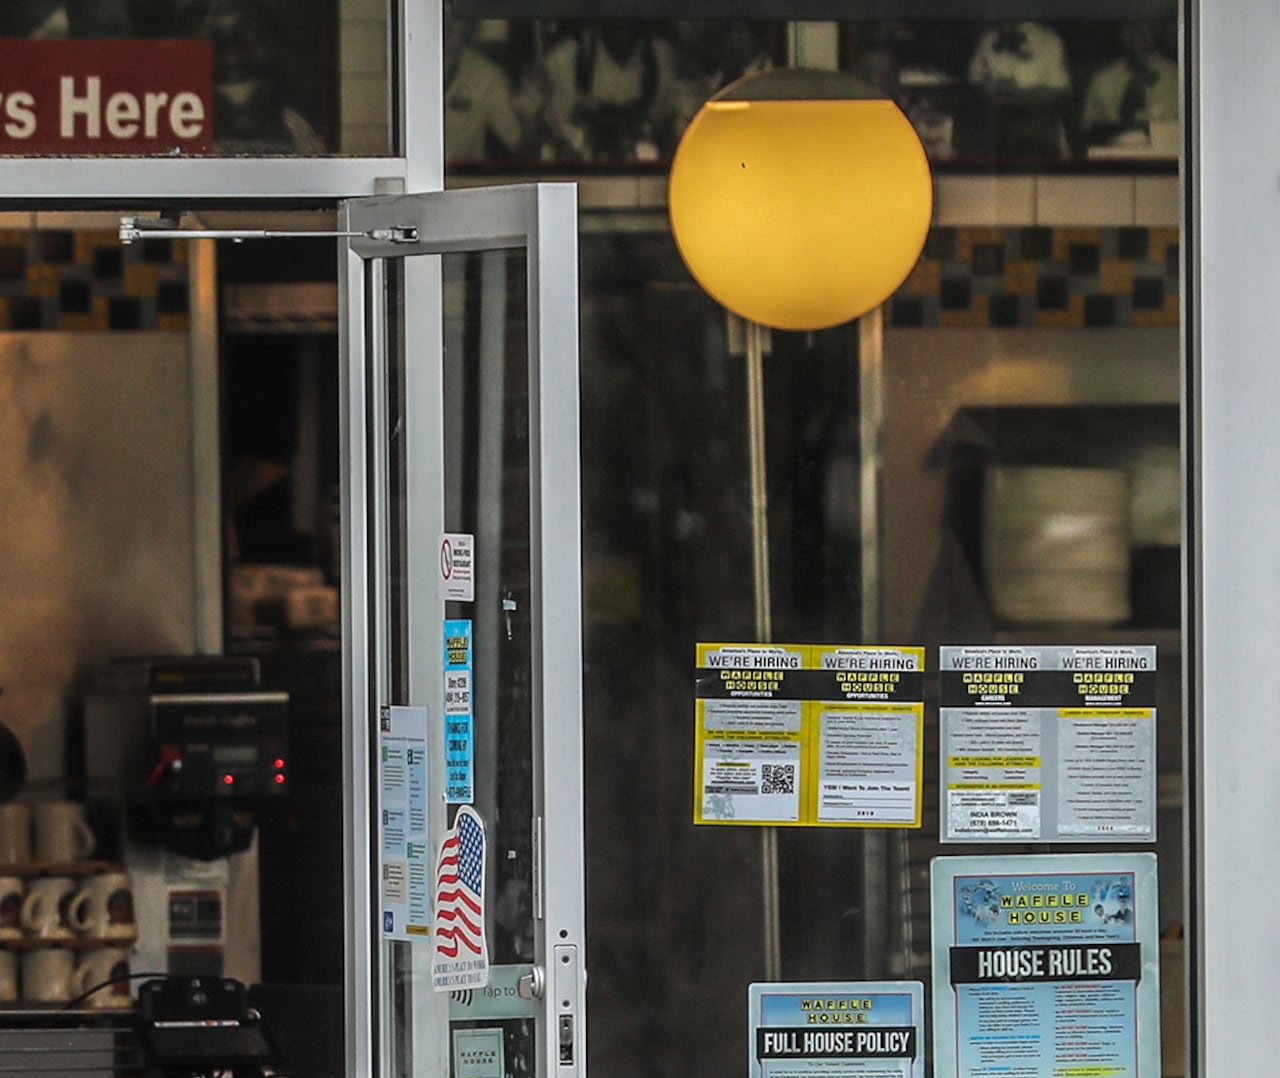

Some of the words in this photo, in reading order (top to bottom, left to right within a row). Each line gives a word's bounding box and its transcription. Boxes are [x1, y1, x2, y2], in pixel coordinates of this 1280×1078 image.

[59, 74, 206, 140] Here
[708, 655, 750, 667] WE'RE
[754, 657, 799, 668] HIRING
[824, 657, 866, 669] WE'RE
[870, 659, 915, 670] HIRING
[952, 657, 992, 669] WE'RE
[995, 657, 1038, 669] HIRING
[1062, 657, 1102, 669] WE'RE
[1105, 657, 1148, 669] HIRING
[720, 670, 784, 680] WAFFLE
[836, 672, 900, 682] WAFFLE
[963, 673, 1024, 683] WAFFLE
[1073, 673, 1135, 683] WAFFLE
[725, 681, 779, 690] HOUSE
[841, 683, 894, 692] HOUSE
[967, 684, 1019, 694] HOUSE
[1078, 684, 1129, 694] HOUSE
[1011, 880, 1060, 892] Welcome
[1063, 880, 1077, 891] To
[1000, 893, 1089, 909] WAFFLE
[1008, 910, 1083, 925] HOUSE
[978, 950, 1045, 978] HOUSE
[1049, 947, 1113, 976] RULES
[482, 985, 502, 1000] Tap
[504, 986, 517, 997] to
[801, 1000, 872, 1011] WAFFLE
[807, 1013, 868, 1024] HOUSE
[764, 1032, 801, 1053] FULL
[804, 1032, 854, 1053] HOUSE
[857, 1031, 910, 1053] POLICY
[460, 1050, 496, 1058] WAFFLE
